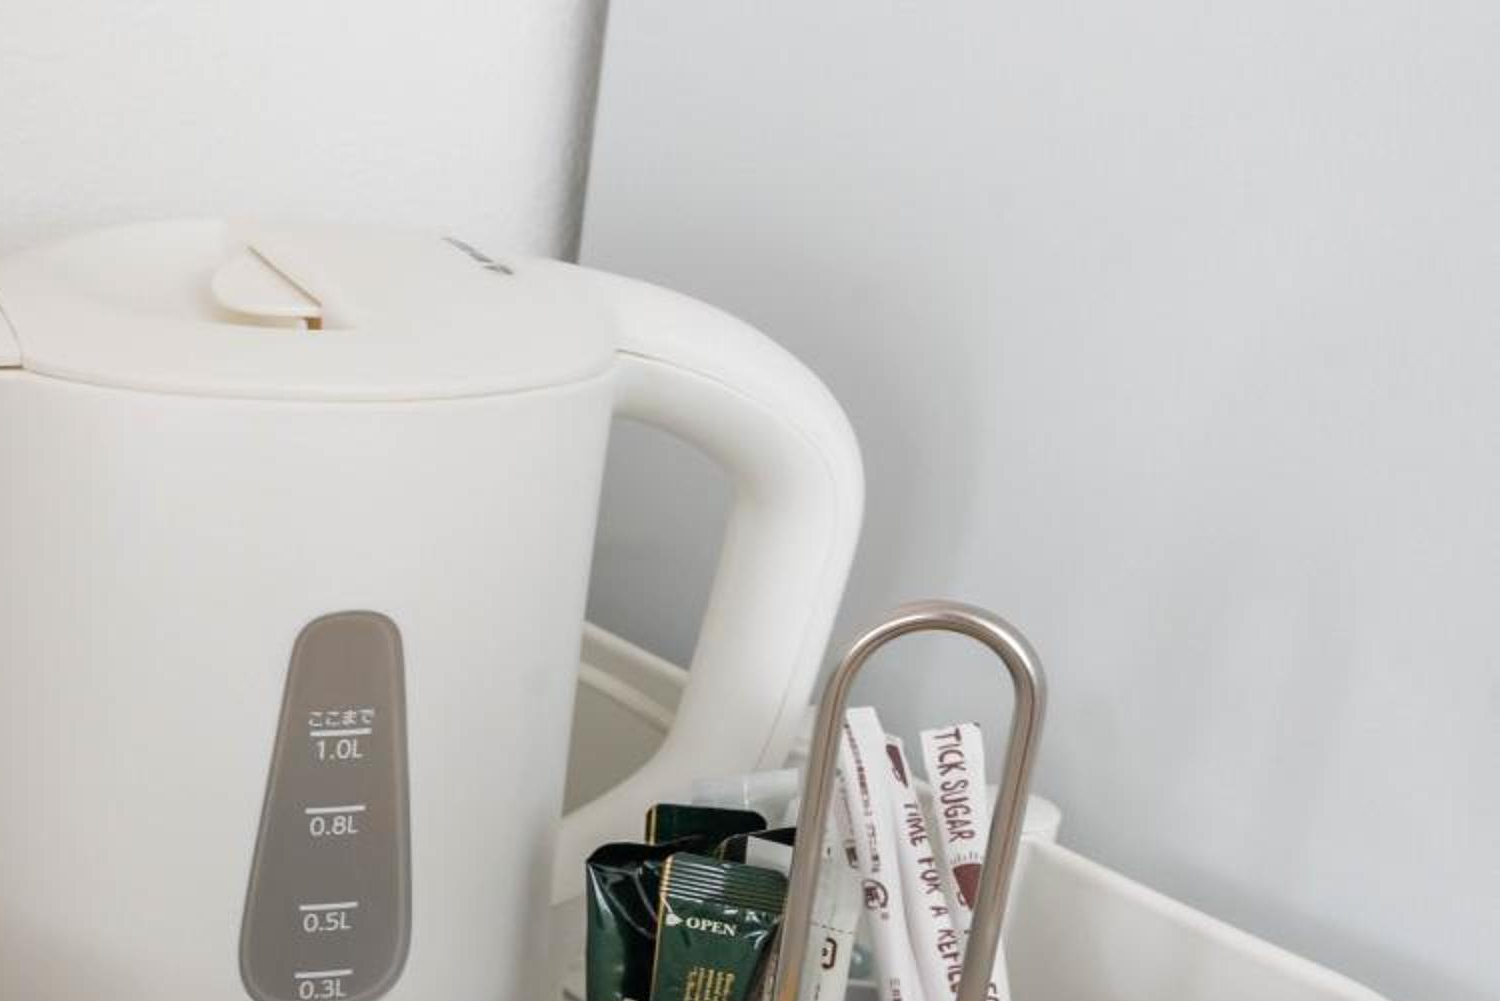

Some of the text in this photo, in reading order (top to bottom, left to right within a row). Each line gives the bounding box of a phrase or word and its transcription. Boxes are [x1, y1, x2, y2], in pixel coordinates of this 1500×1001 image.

[308, 708, 375, 727] ここまで
[316, 739, 363, 761] 1.0L
[940, 779, 976, 843] SUGAR
[309, 815, 359, 837] 0.8L
[303, 912, 352, 933] 0.5L
[685, 916, 738, 937] OPEN
[937, 928, 963, 993] REFIL
[299, 979, 348, 1000] 0.3L
